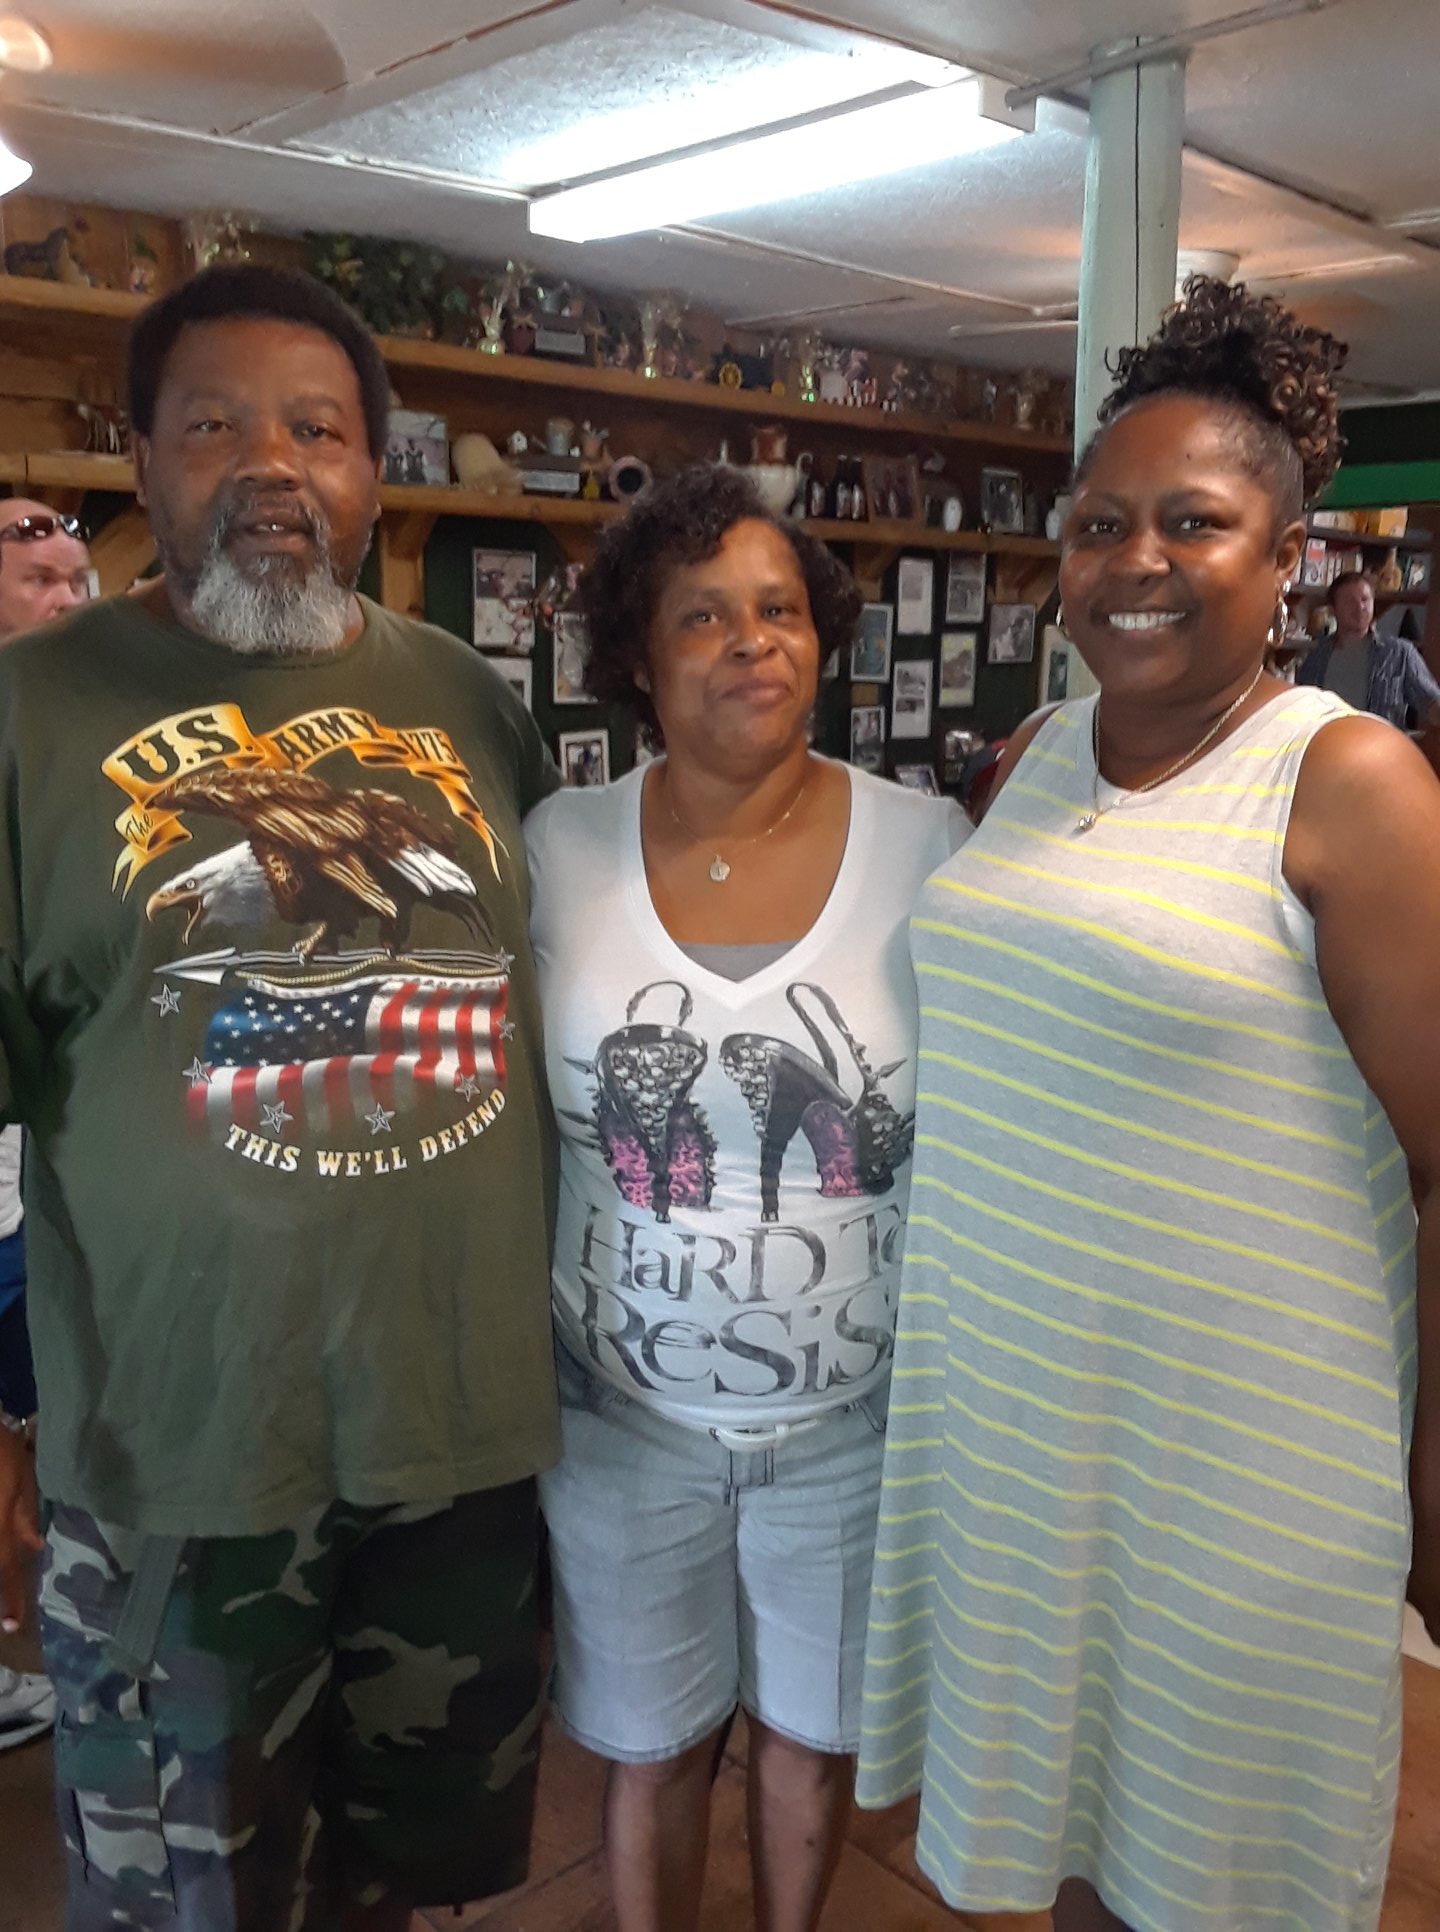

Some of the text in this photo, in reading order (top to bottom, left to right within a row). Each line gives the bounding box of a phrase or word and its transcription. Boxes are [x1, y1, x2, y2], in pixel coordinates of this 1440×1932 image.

[271, 711, 384, 771] ARMY
[397, 730, 458, 765] 1775
[125, 813, 154, 845] The
[224, 1088, 507, 1177] THIS WE'LL DEFEND
